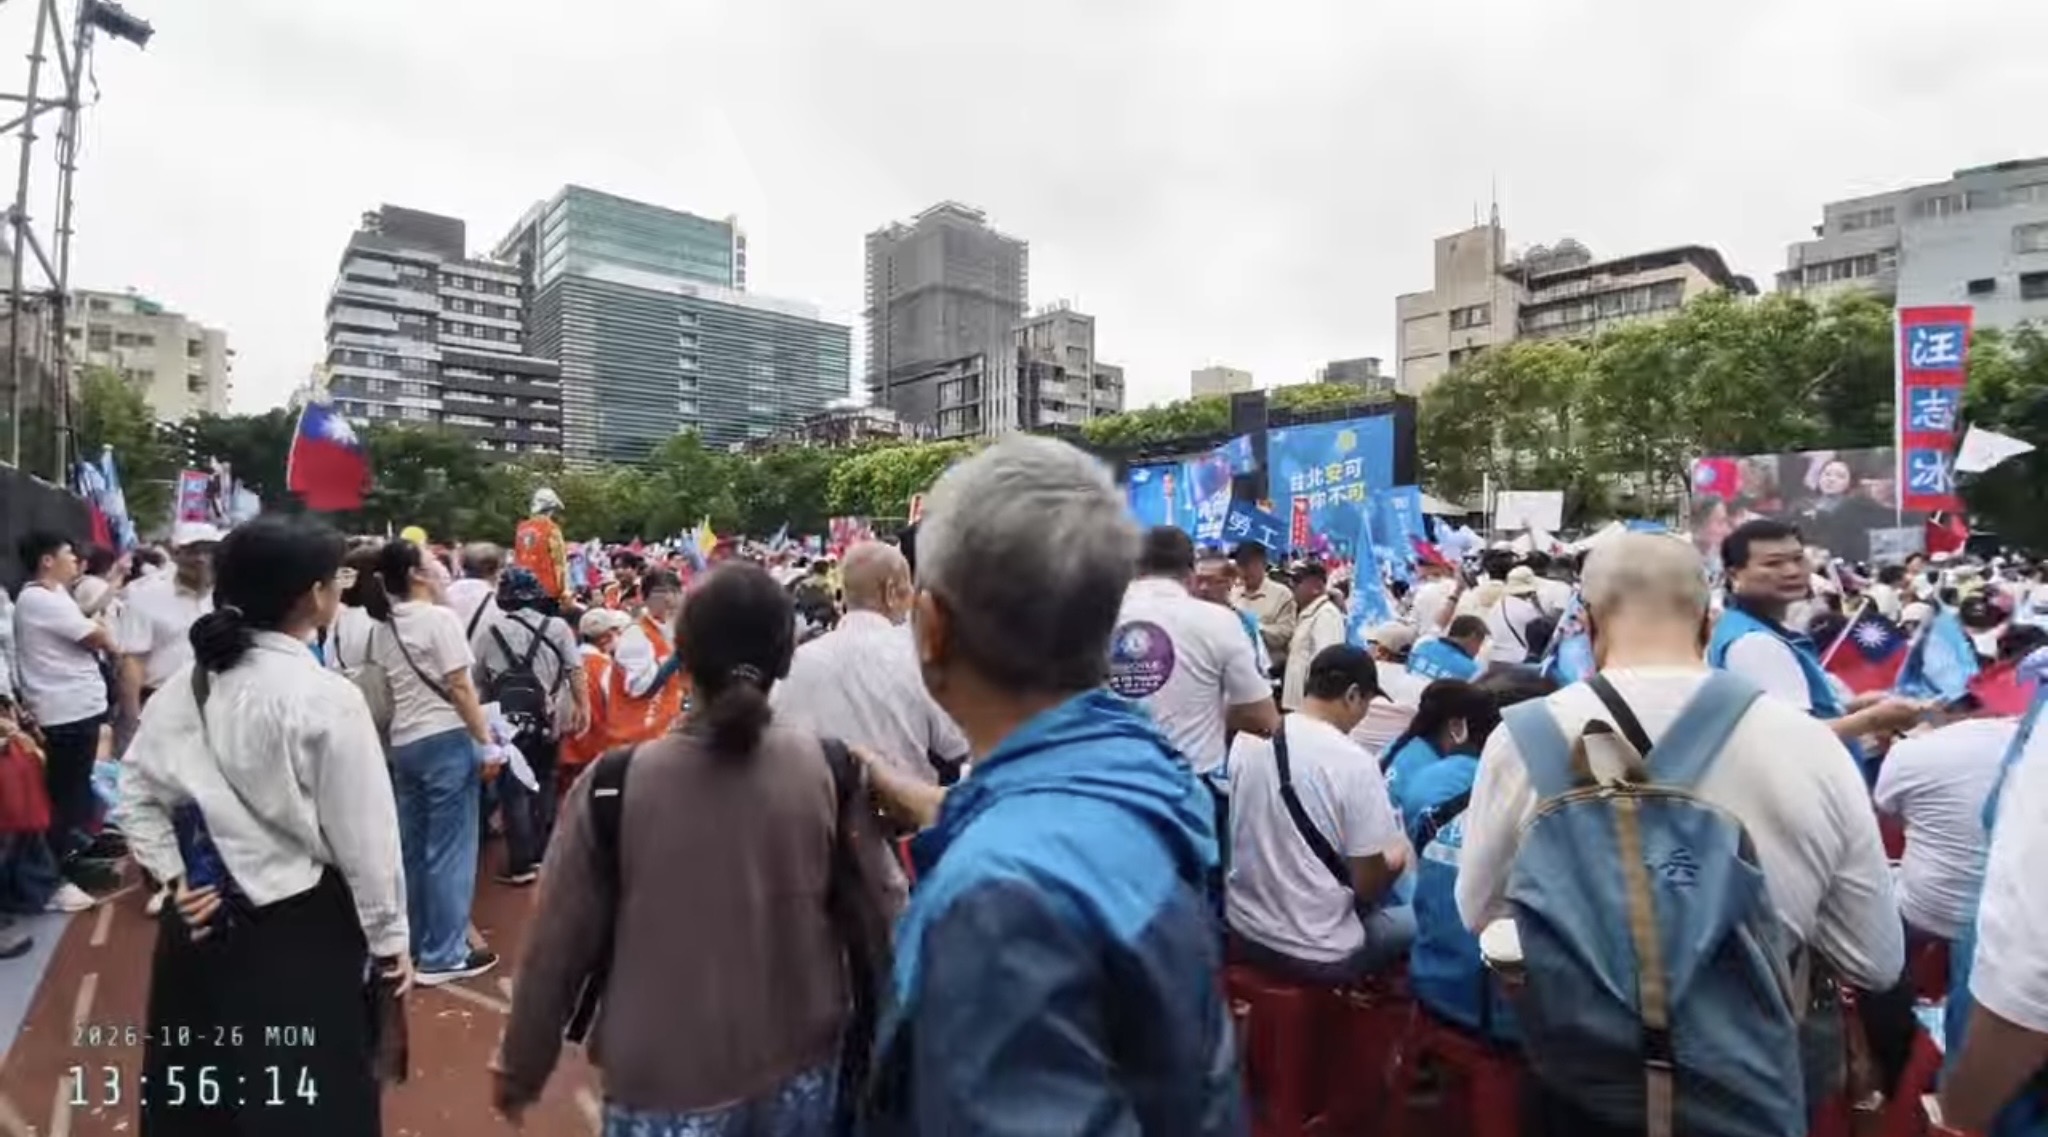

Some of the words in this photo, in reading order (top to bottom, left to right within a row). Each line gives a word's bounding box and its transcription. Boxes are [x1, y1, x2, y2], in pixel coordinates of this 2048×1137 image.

[1910, 328, 1959, 493] 汪志冰
[1308, 482, 1365, 510] 你不可
